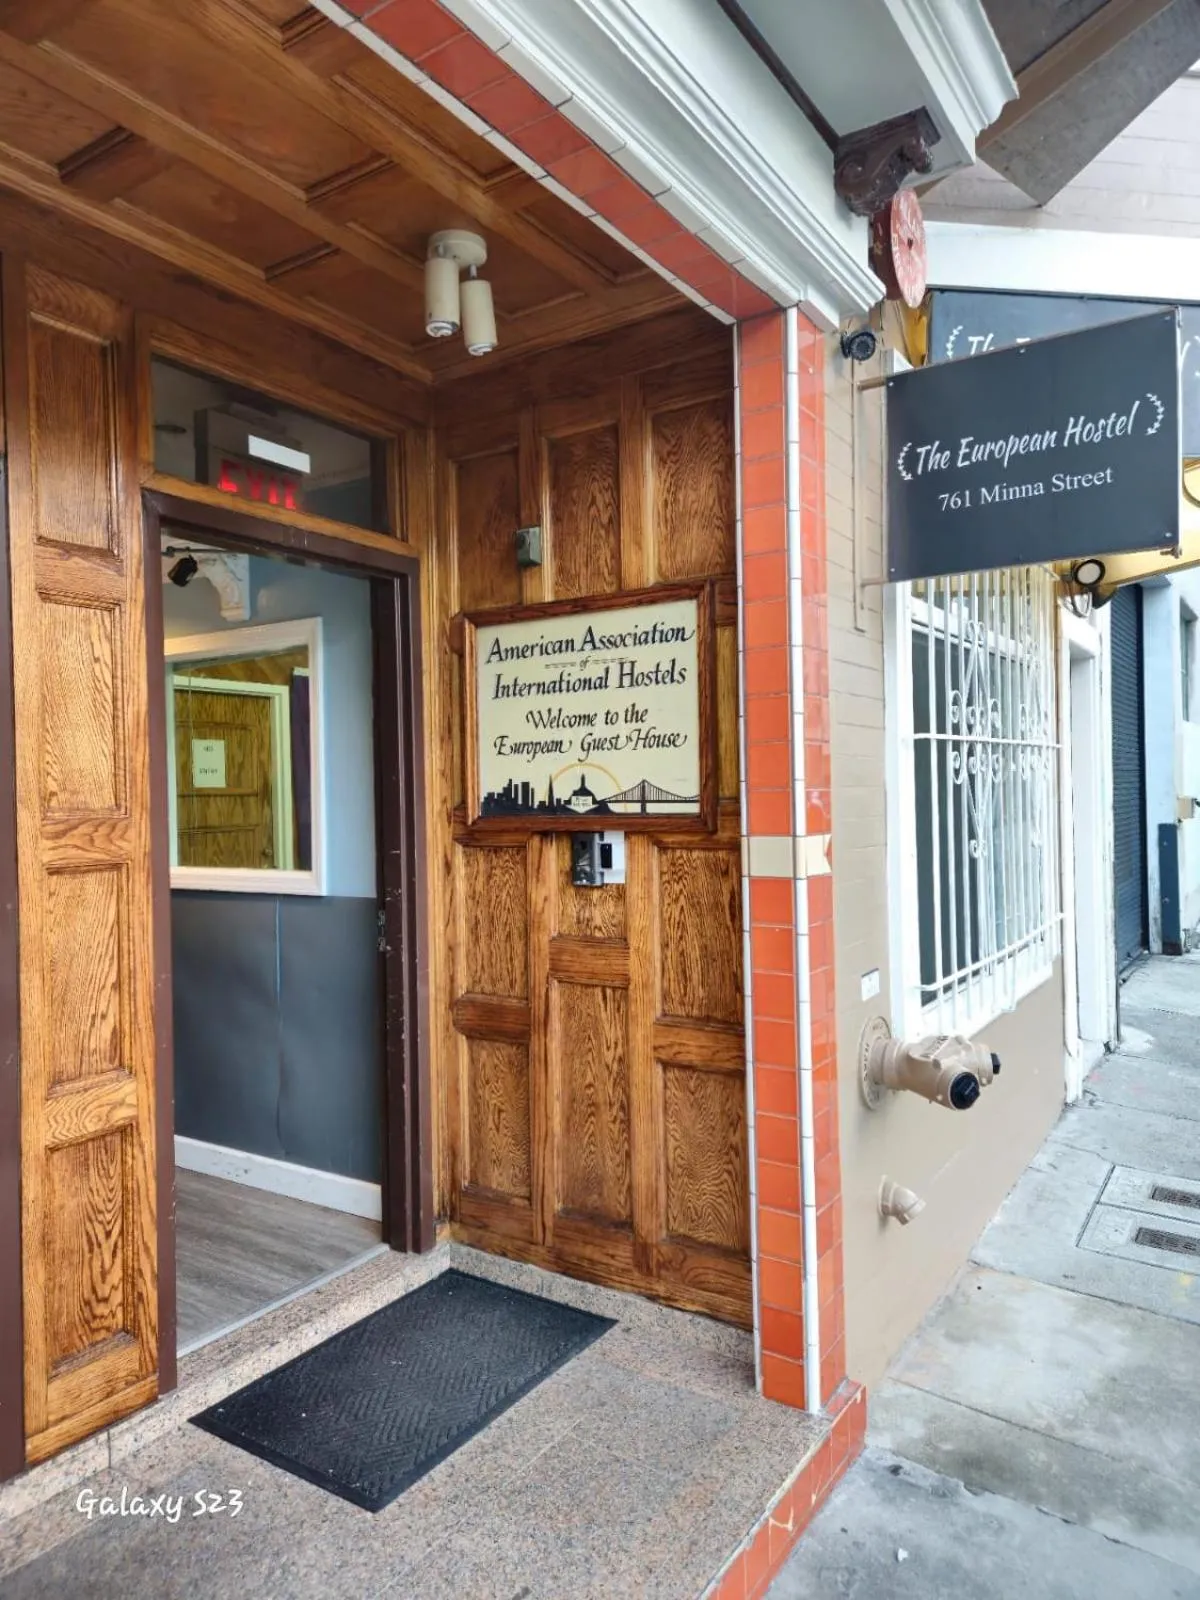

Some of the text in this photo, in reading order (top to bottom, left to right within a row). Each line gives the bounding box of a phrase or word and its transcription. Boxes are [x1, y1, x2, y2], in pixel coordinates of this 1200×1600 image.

[916, 400, 1140, 476] The European Hostel
[938, 467, 1114, 512] 761 Minna Street
[484, 621, 695, 665] American Association
[579, 655, 592, 671] of
[492, 657, 688, 700] International Hostels
[525, 702, 649, 730] Welcome to the
[493, 726, 688, 763] European Guest House
